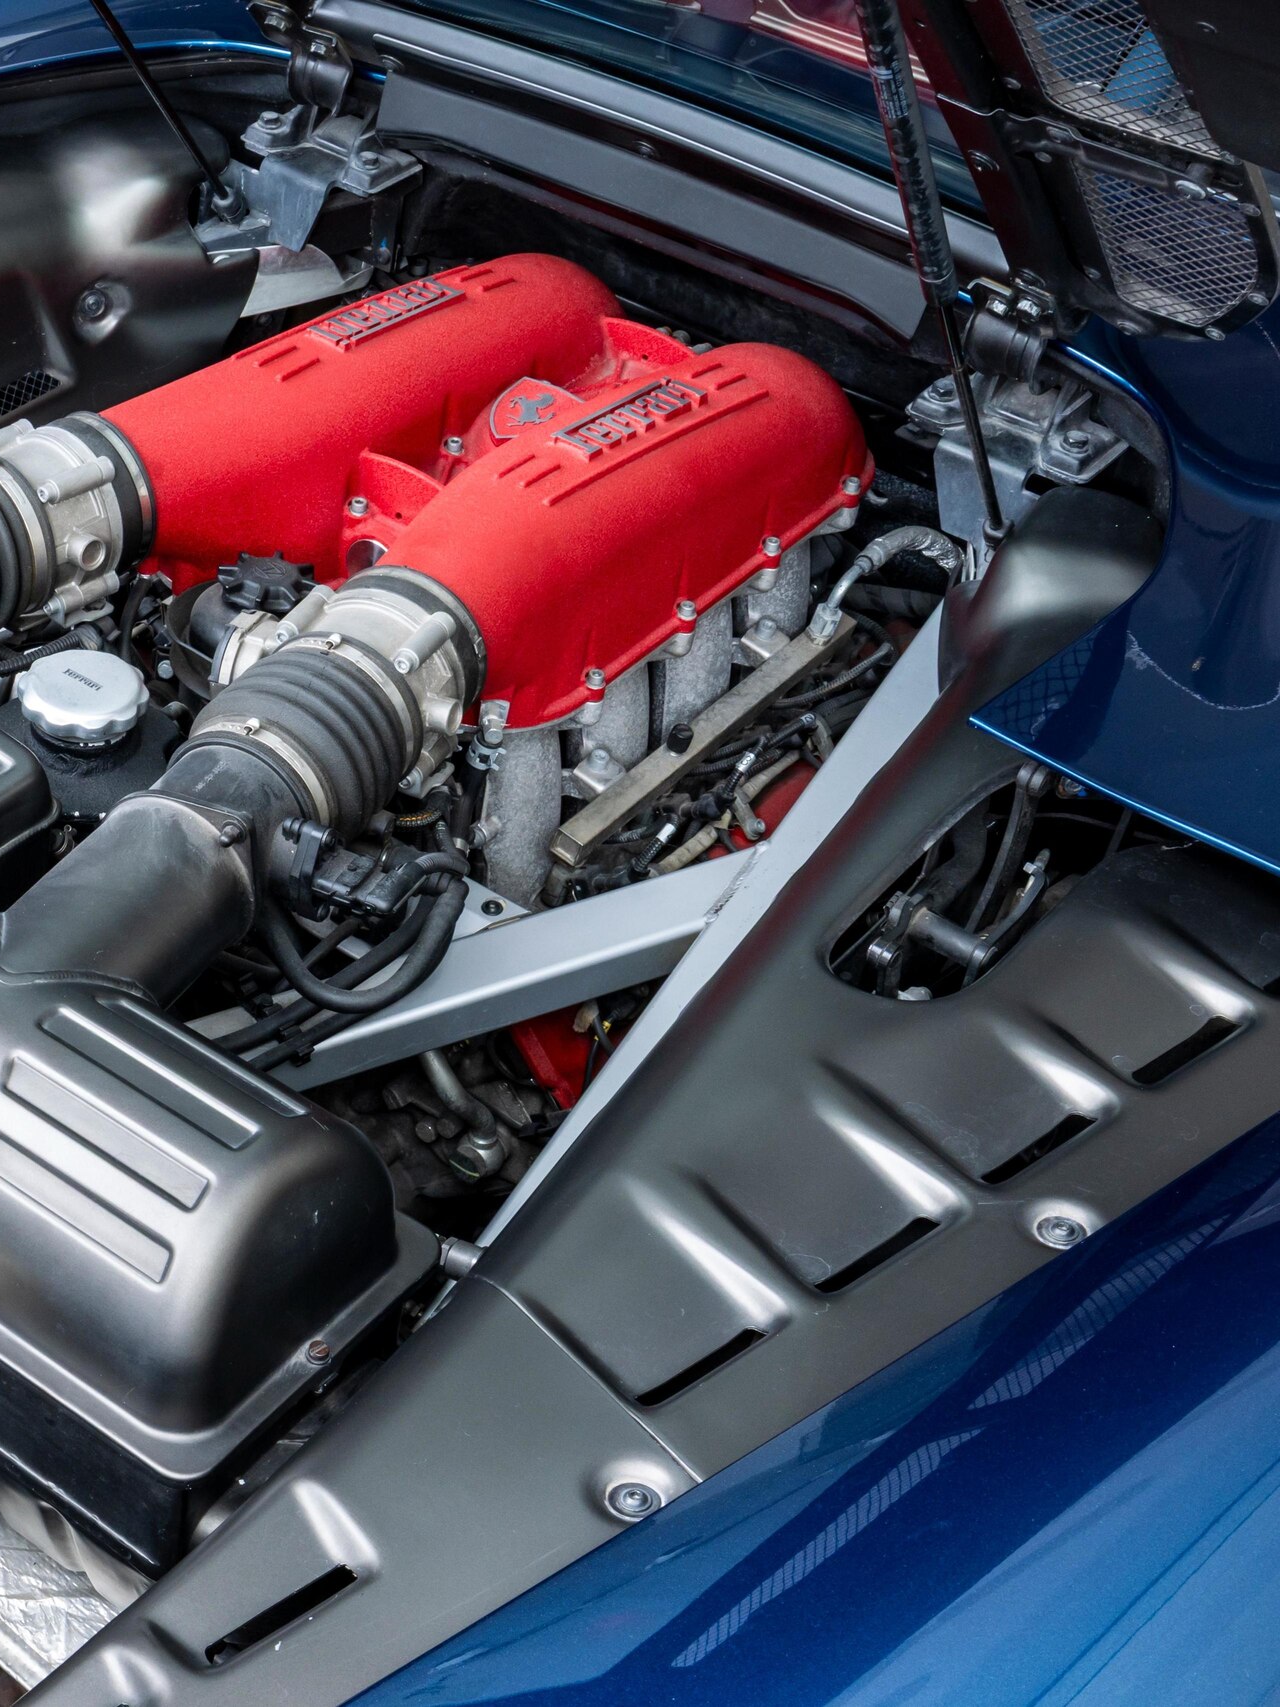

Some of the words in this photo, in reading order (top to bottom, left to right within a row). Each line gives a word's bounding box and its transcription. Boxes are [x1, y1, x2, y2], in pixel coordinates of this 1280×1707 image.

[307, 277, 466, 351] Ferrari
[552, 376, 708, 461] Ferrari
[62, 668, 103, 691] Ferrari
